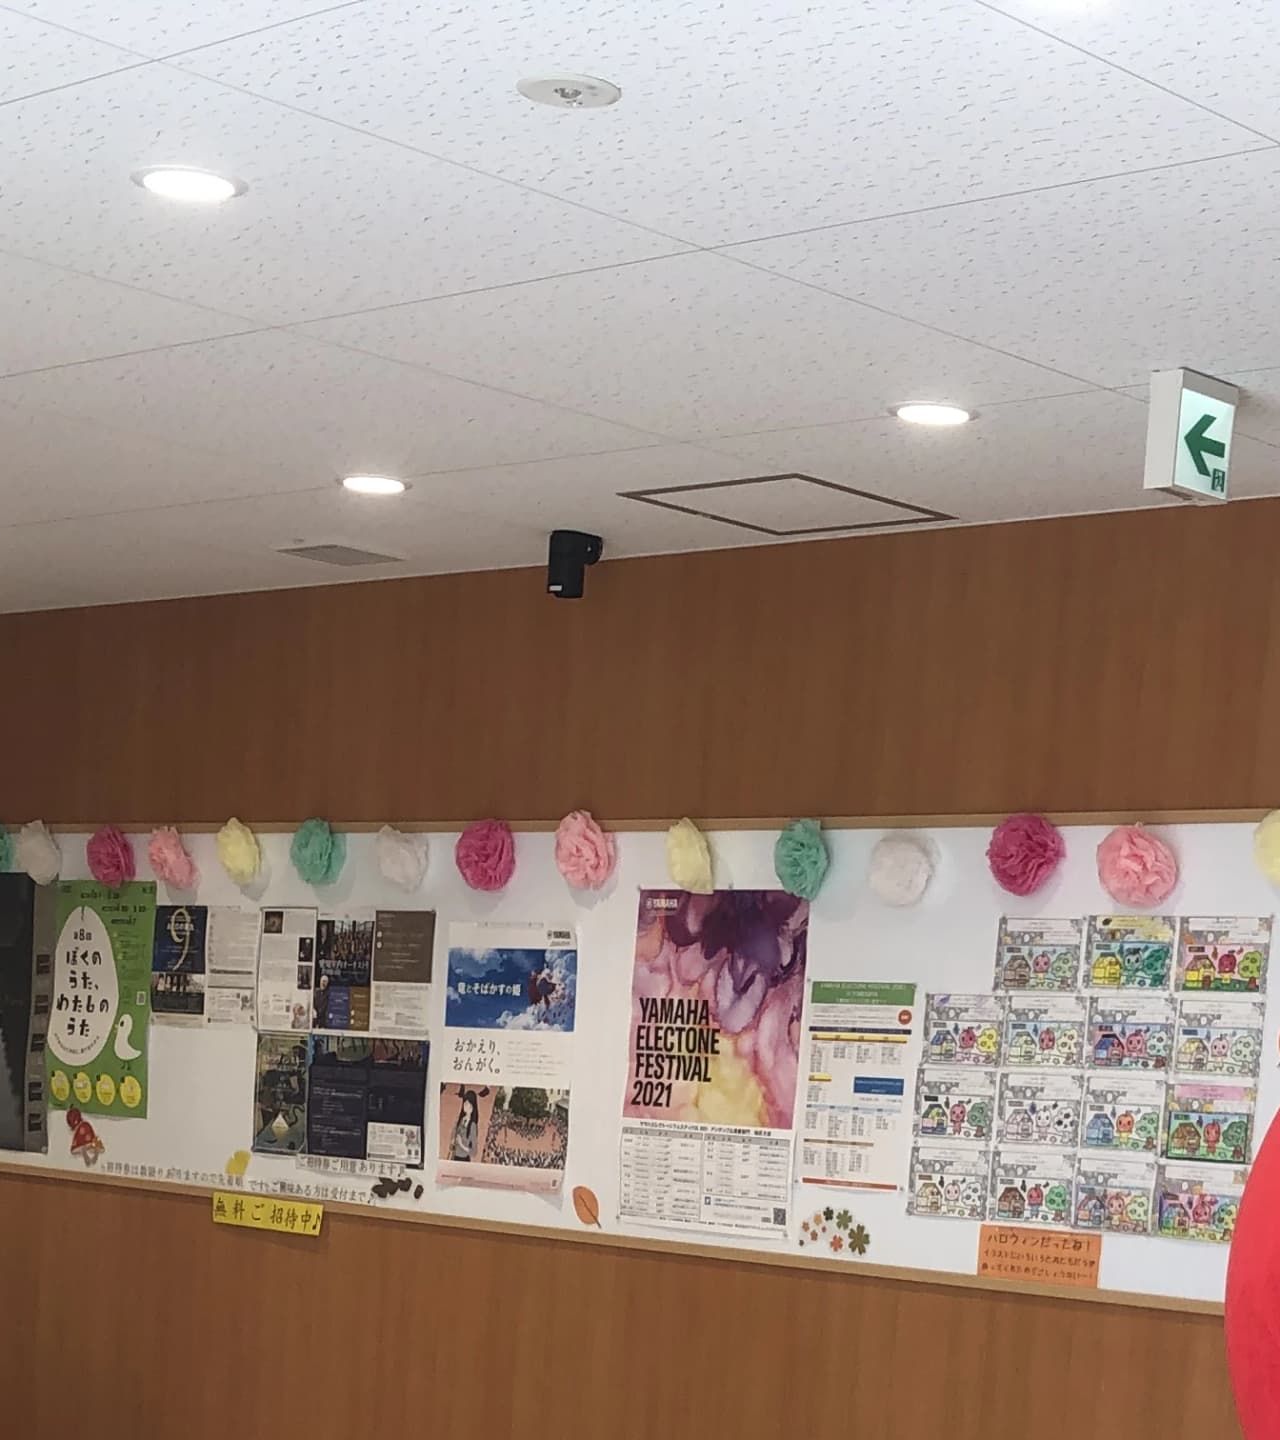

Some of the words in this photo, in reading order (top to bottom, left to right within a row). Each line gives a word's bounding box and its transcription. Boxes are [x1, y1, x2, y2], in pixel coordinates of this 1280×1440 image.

[66, 947, 102, 966] ぼくの
[457, 981, 521, 997] 竜とそばかすの姫
[639, 997, 709, 1025] YAMAHA
[67, 1017, 90, 1037] うた
[454, 1038, 501, 1056] おかえり、
[636, 1026, 720, 1054] ELECTONE
[453, 1057, 500, 1075] おんがく。
[635, 1053, 712, 1082] FESTIVAL
[631, 1081, 672, 1107] 2021
